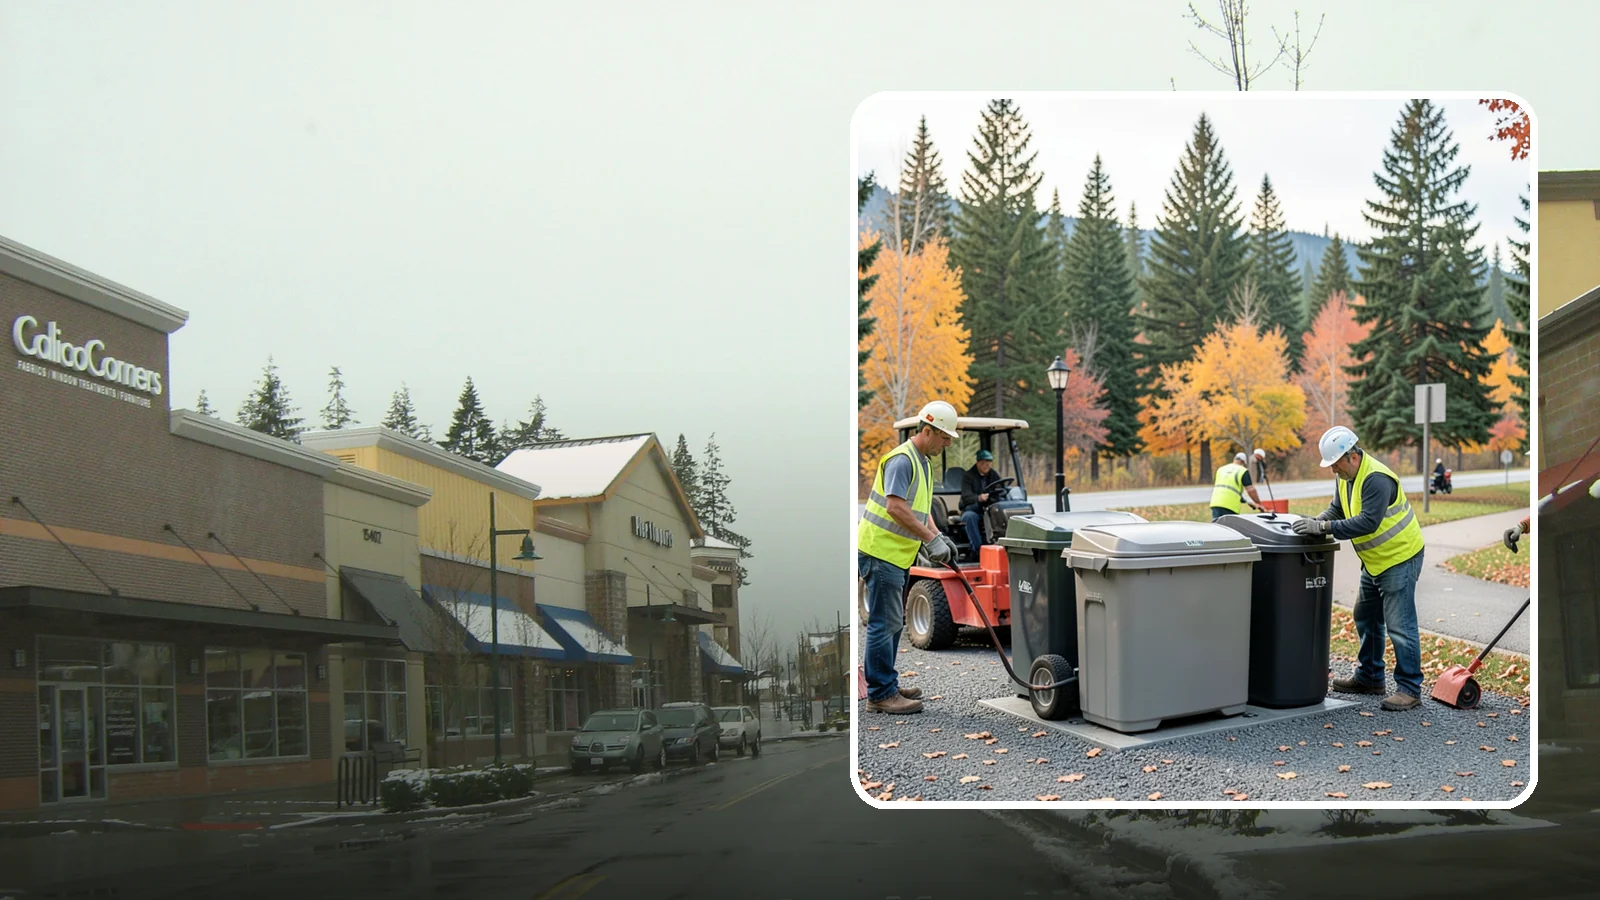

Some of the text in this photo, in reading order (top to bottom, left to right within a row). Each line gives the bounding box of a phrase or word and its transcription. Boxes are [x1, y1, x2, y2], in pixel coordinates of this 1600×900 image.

[17, 360, 47, 377] FABRICS
[51, 371, 78, 386] WINDOW
[79, 379, 116, 398] TREATMENTS
